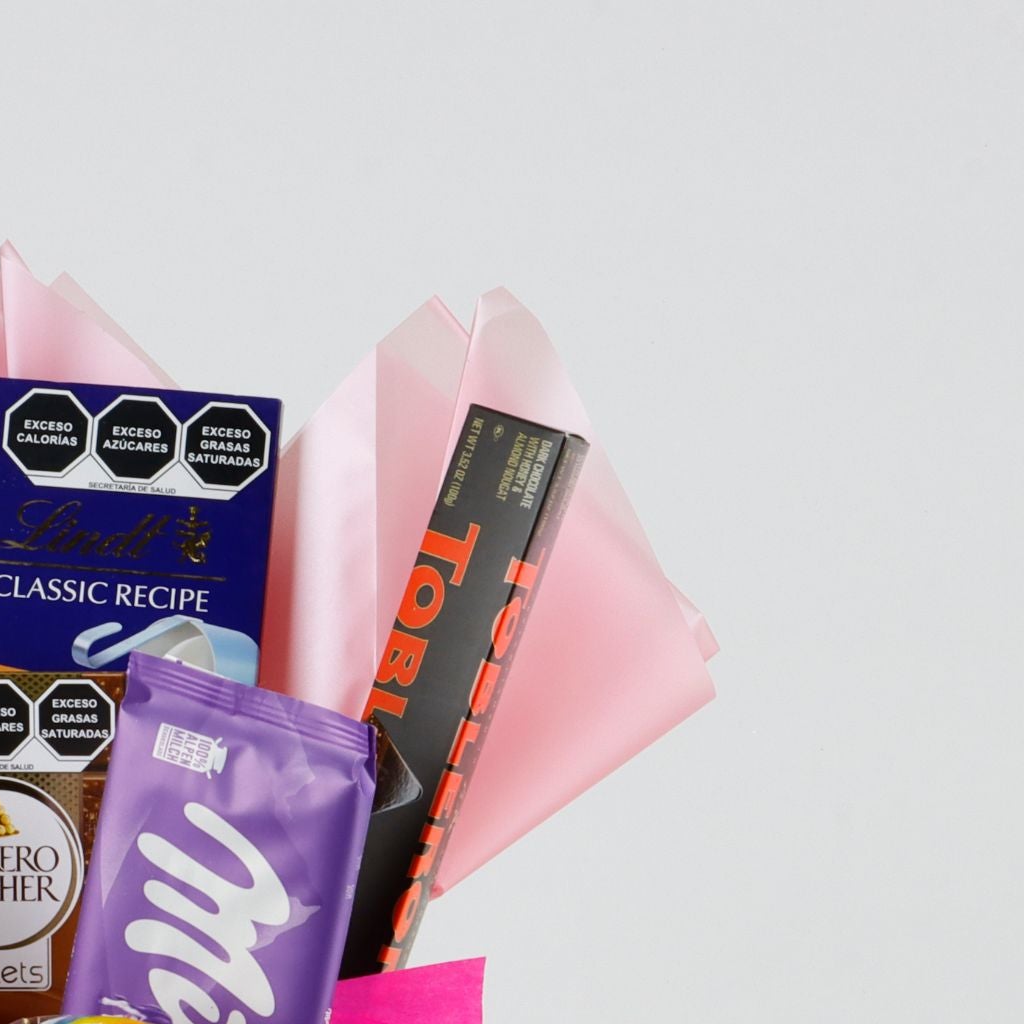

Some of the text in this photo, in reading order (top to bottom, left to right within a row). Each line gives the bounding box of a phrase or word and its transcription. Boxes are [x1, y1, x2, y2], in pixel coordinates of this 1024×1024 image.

[23, 419, 74, 433] EXCESO
[112, 425, 162, 440] EXCESO
[201, 426, 252, 440] EXCESO
[470, 417, 485, 435] NET
[16, 432, 78, 447] CALORÍAS
[102, 437, 169, 454] AZÚCARES
[199, 439, 251, 454] GRASAS
[465, 434, 479, 451] WT
[523, 436, 540, 460] WITH
[187, 452, 261, 468] SATURADAS
[458, 450, 473, 470] 3.52
[496, 431, 528, 502] ALMOND NOUGAT
[453, 469, 466, 482] OZ
[515, 458, 533, 487] HONEY
[520, 439, 553, 510] DARK CHOCOLATE
[115, 584, 210, 613] RECIPE
[52, 698, 98, 709] EXCESO
[51, 713, 98, 724] GRASAS
[41, 728, 109, 739] SATURADAS
[166, 728, 186, 762] MILCH
[179, 733, 198, 767] ALPEN
[192, 738, 213, 769] 100%
